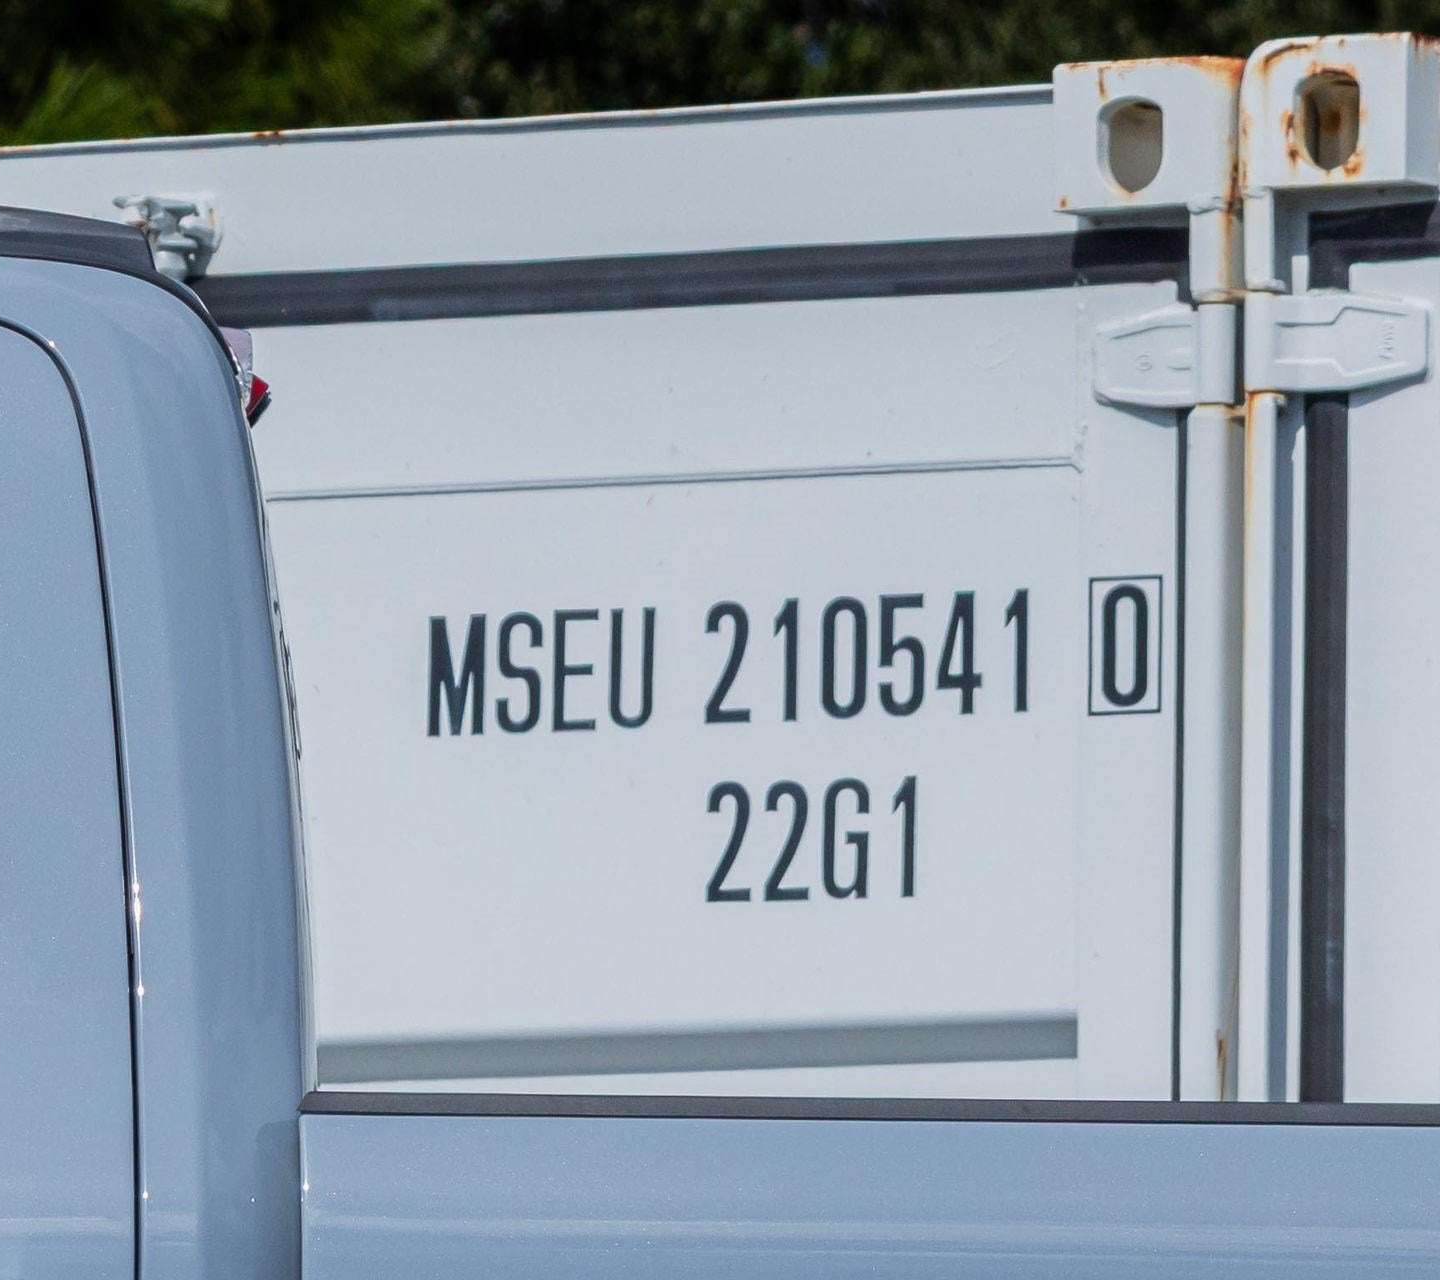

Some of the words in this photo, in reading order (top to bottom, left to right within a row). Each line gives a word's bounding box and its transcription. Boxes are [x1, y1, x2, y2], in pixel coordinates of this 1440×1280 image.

[427, 607, 655, 737] MSEU
[704, 589, 1029, 724] 210541
[706, 776, 916, 902] 22G1
